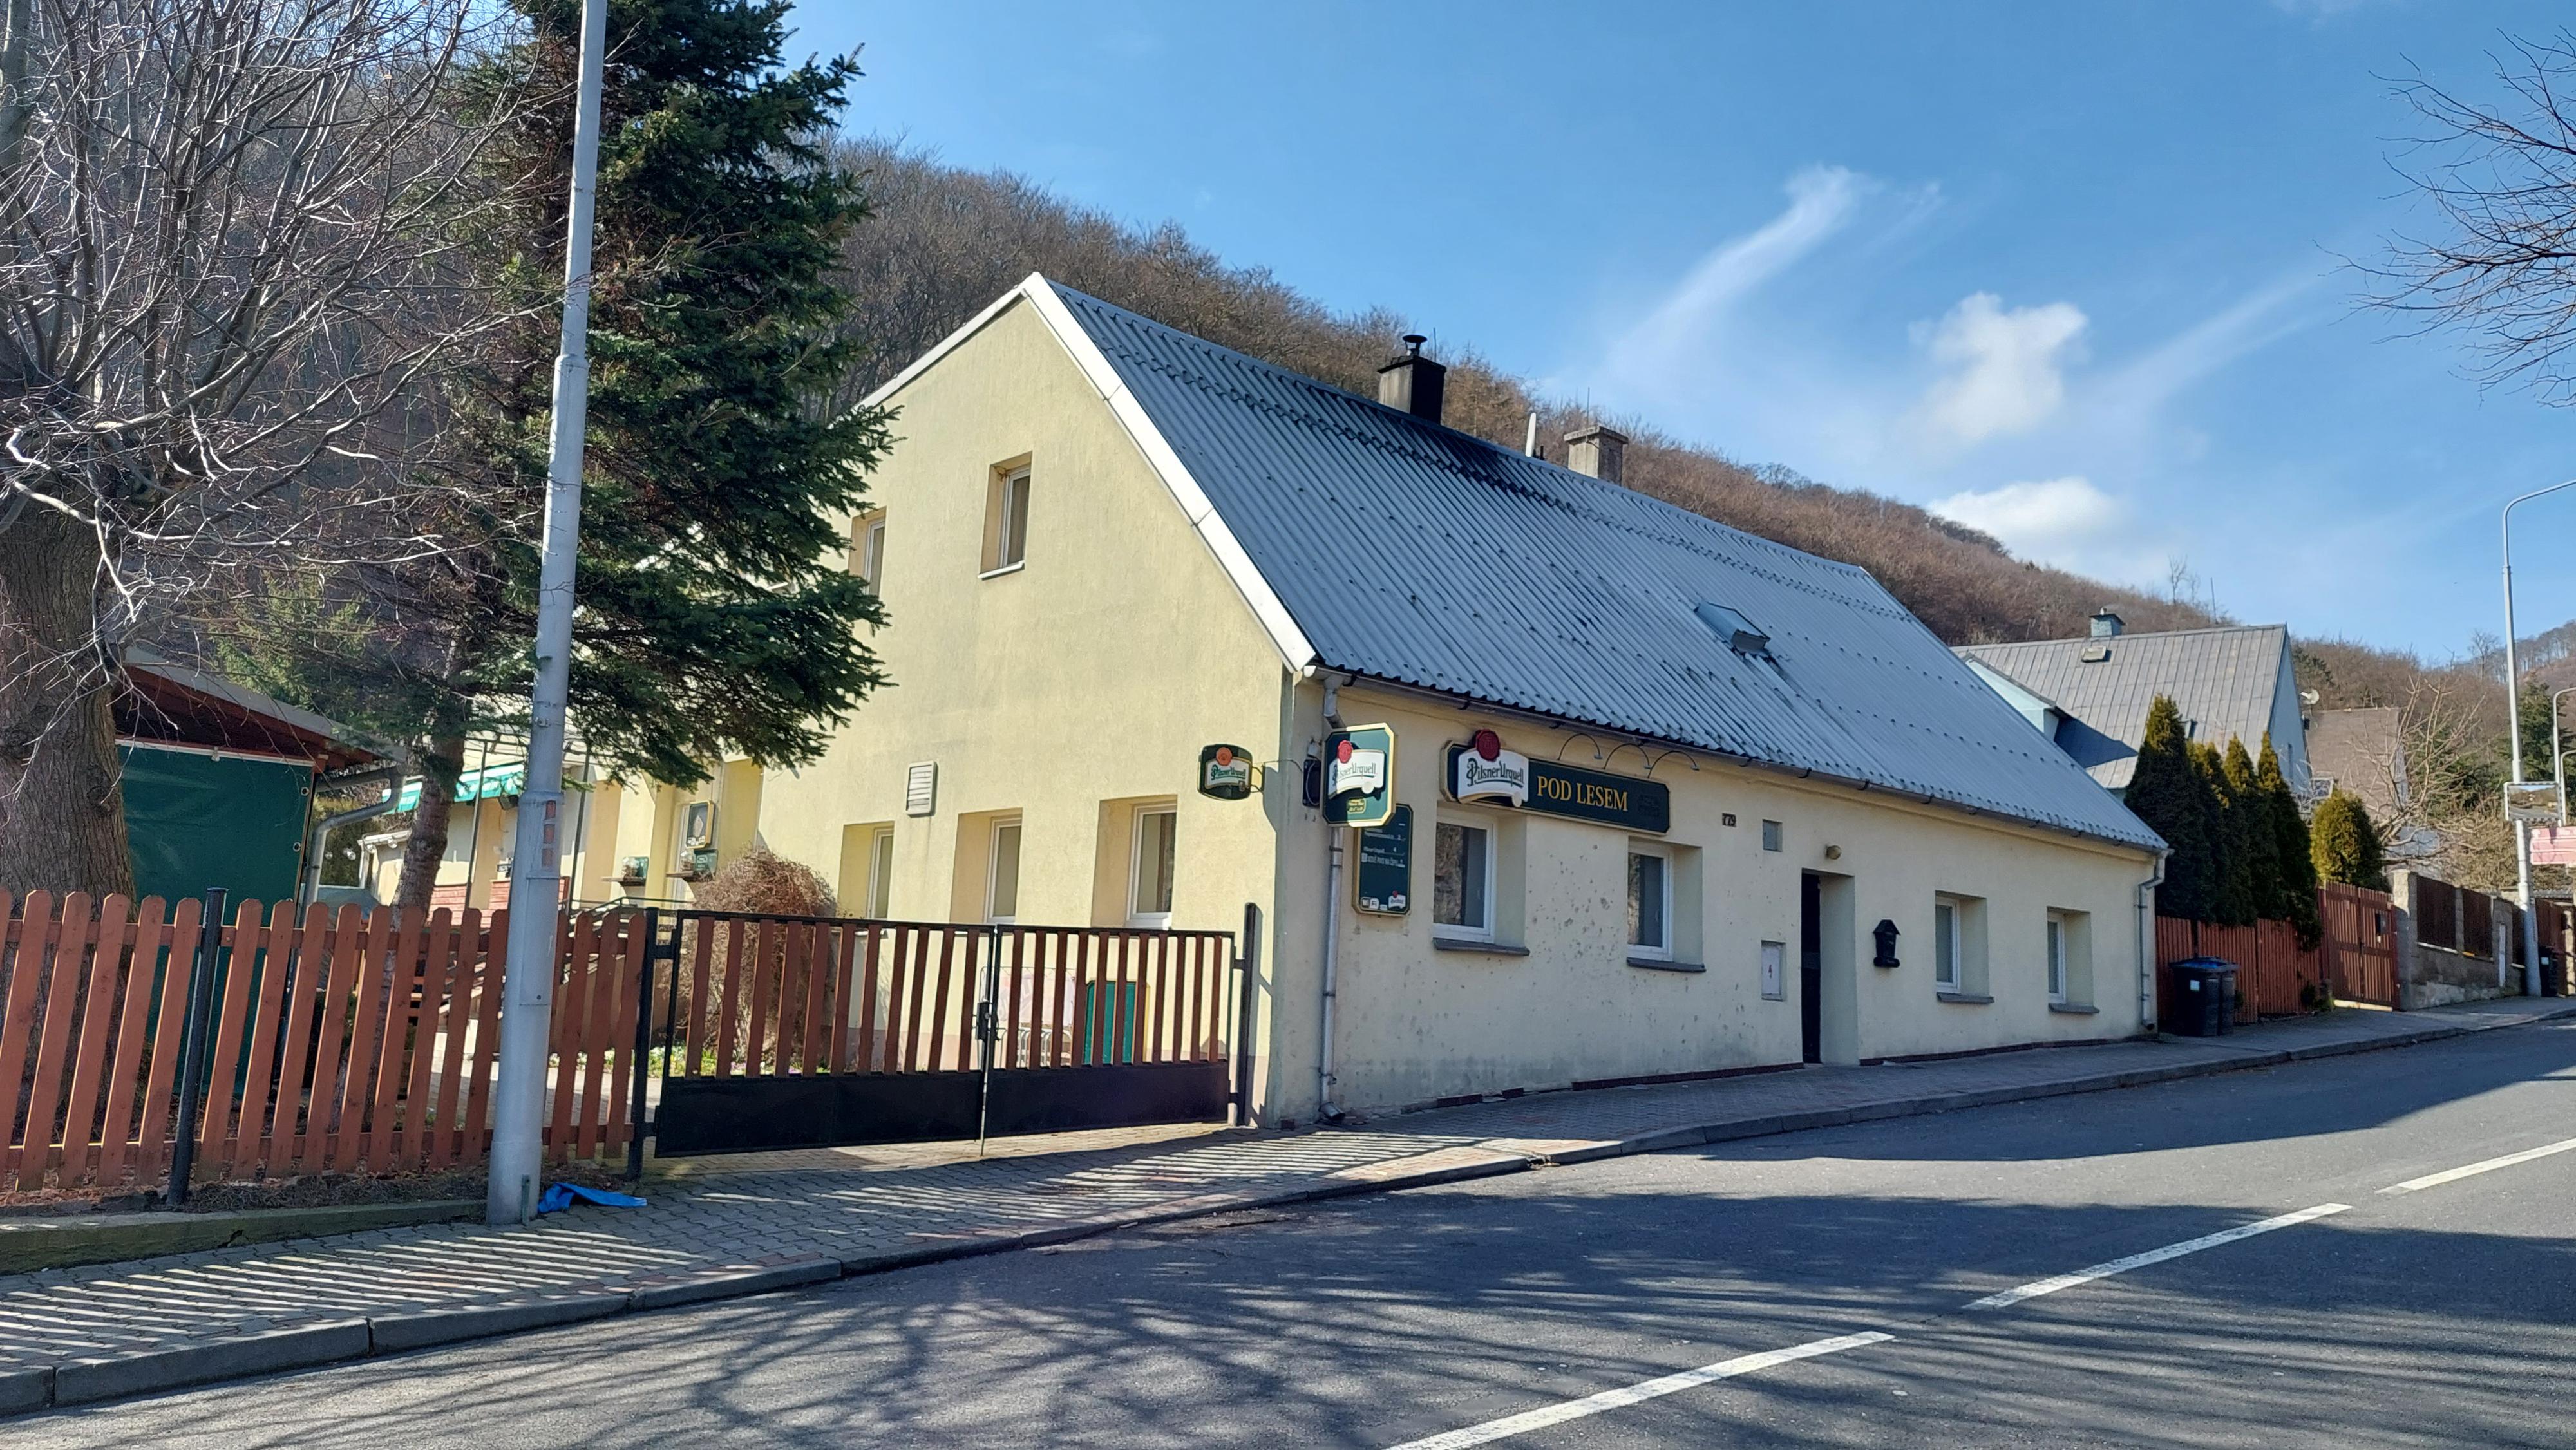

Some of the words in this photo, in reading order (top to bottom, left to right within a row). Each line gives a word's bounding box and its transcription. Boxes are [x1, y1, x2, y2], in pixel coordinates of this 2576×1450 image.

[1332, 764, 1353, 786] Psner
[1352, 762, 1376, 778] Urquell
[1466, 757, 1499, 787] Pilsner
[1499, 760, 1525, 787] Urquell
[1537, 775, 1572, 801] POD
[1577, 782, 1629, 811] LESEM
[1722, 813, 1736, 827] 779
